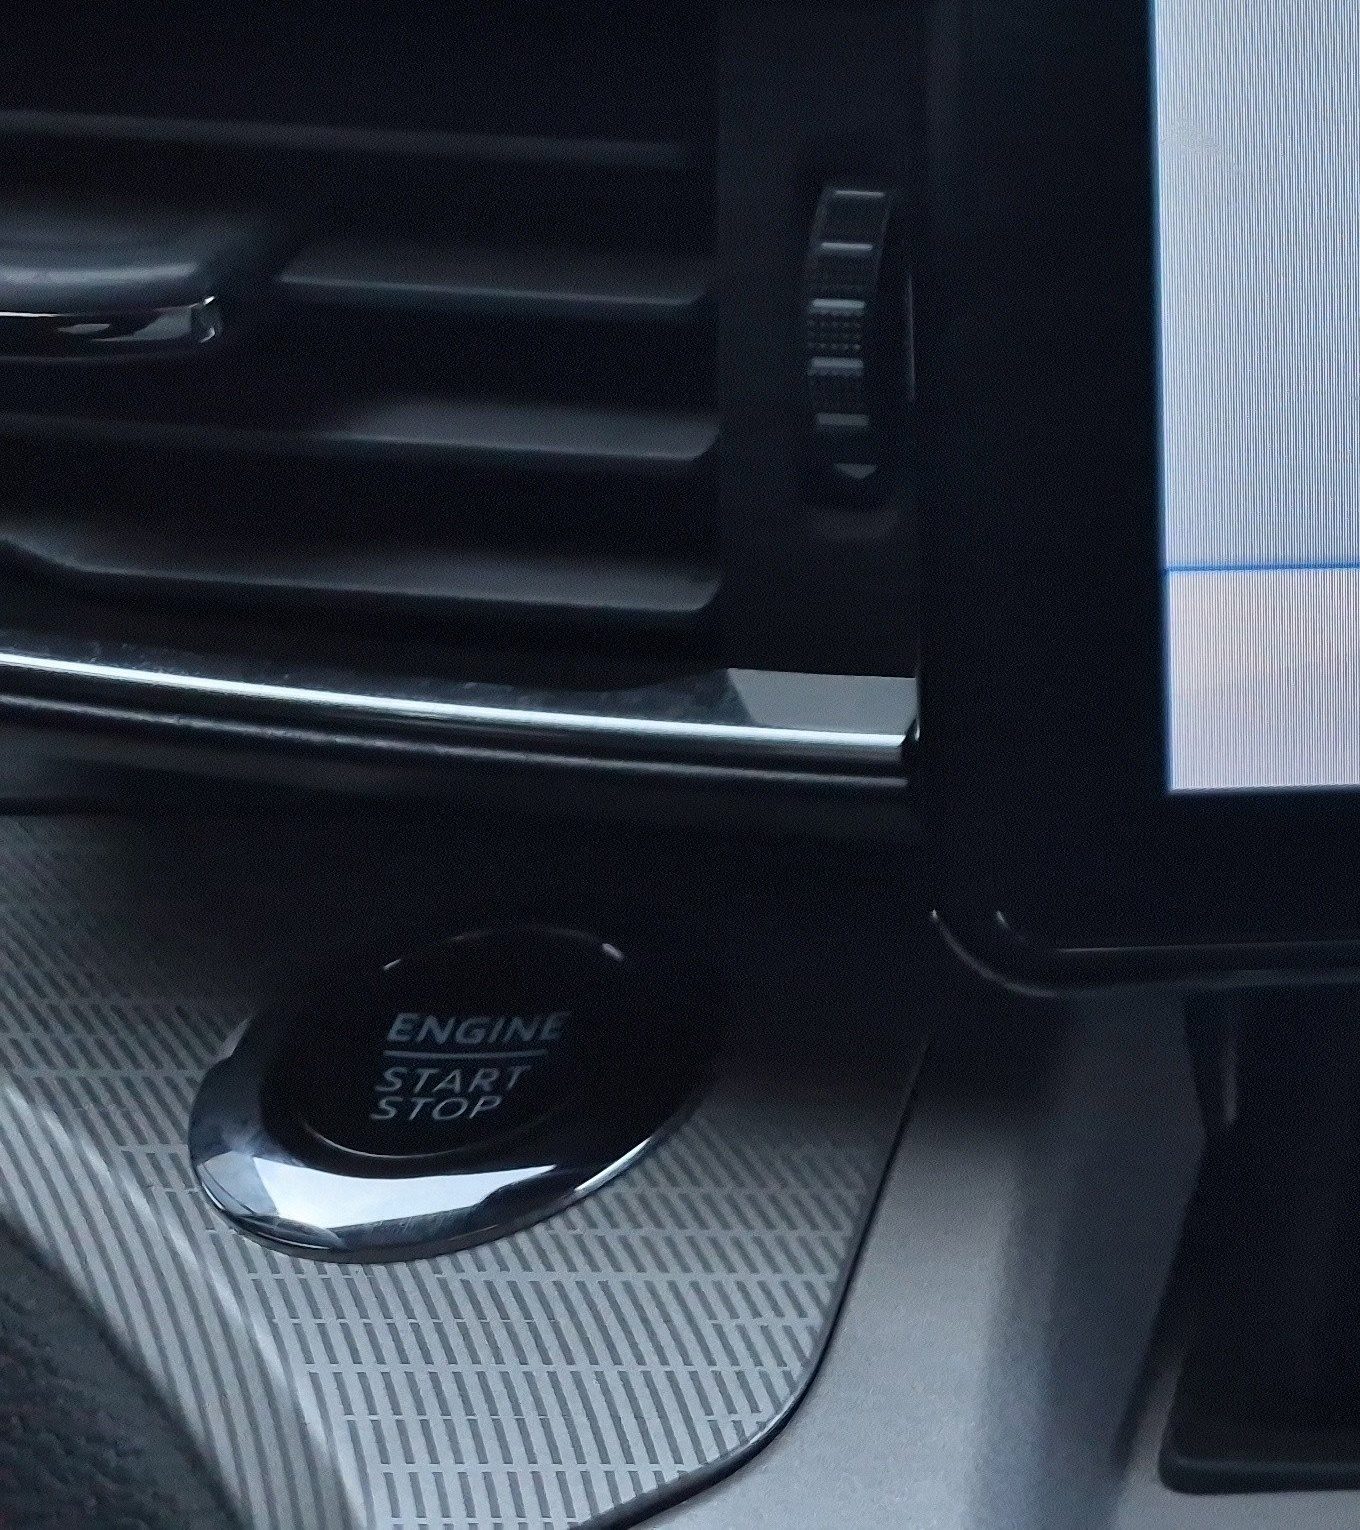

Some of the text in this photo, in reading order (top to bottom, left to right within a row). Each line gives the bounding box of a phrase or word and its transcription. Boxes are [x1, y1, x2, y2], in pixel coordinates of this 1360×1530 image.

[386, 1010, 571, 1046] ENGINE
[374, 1064, 531, 1095] START
[369, 1095, 502, 1121] STOP
